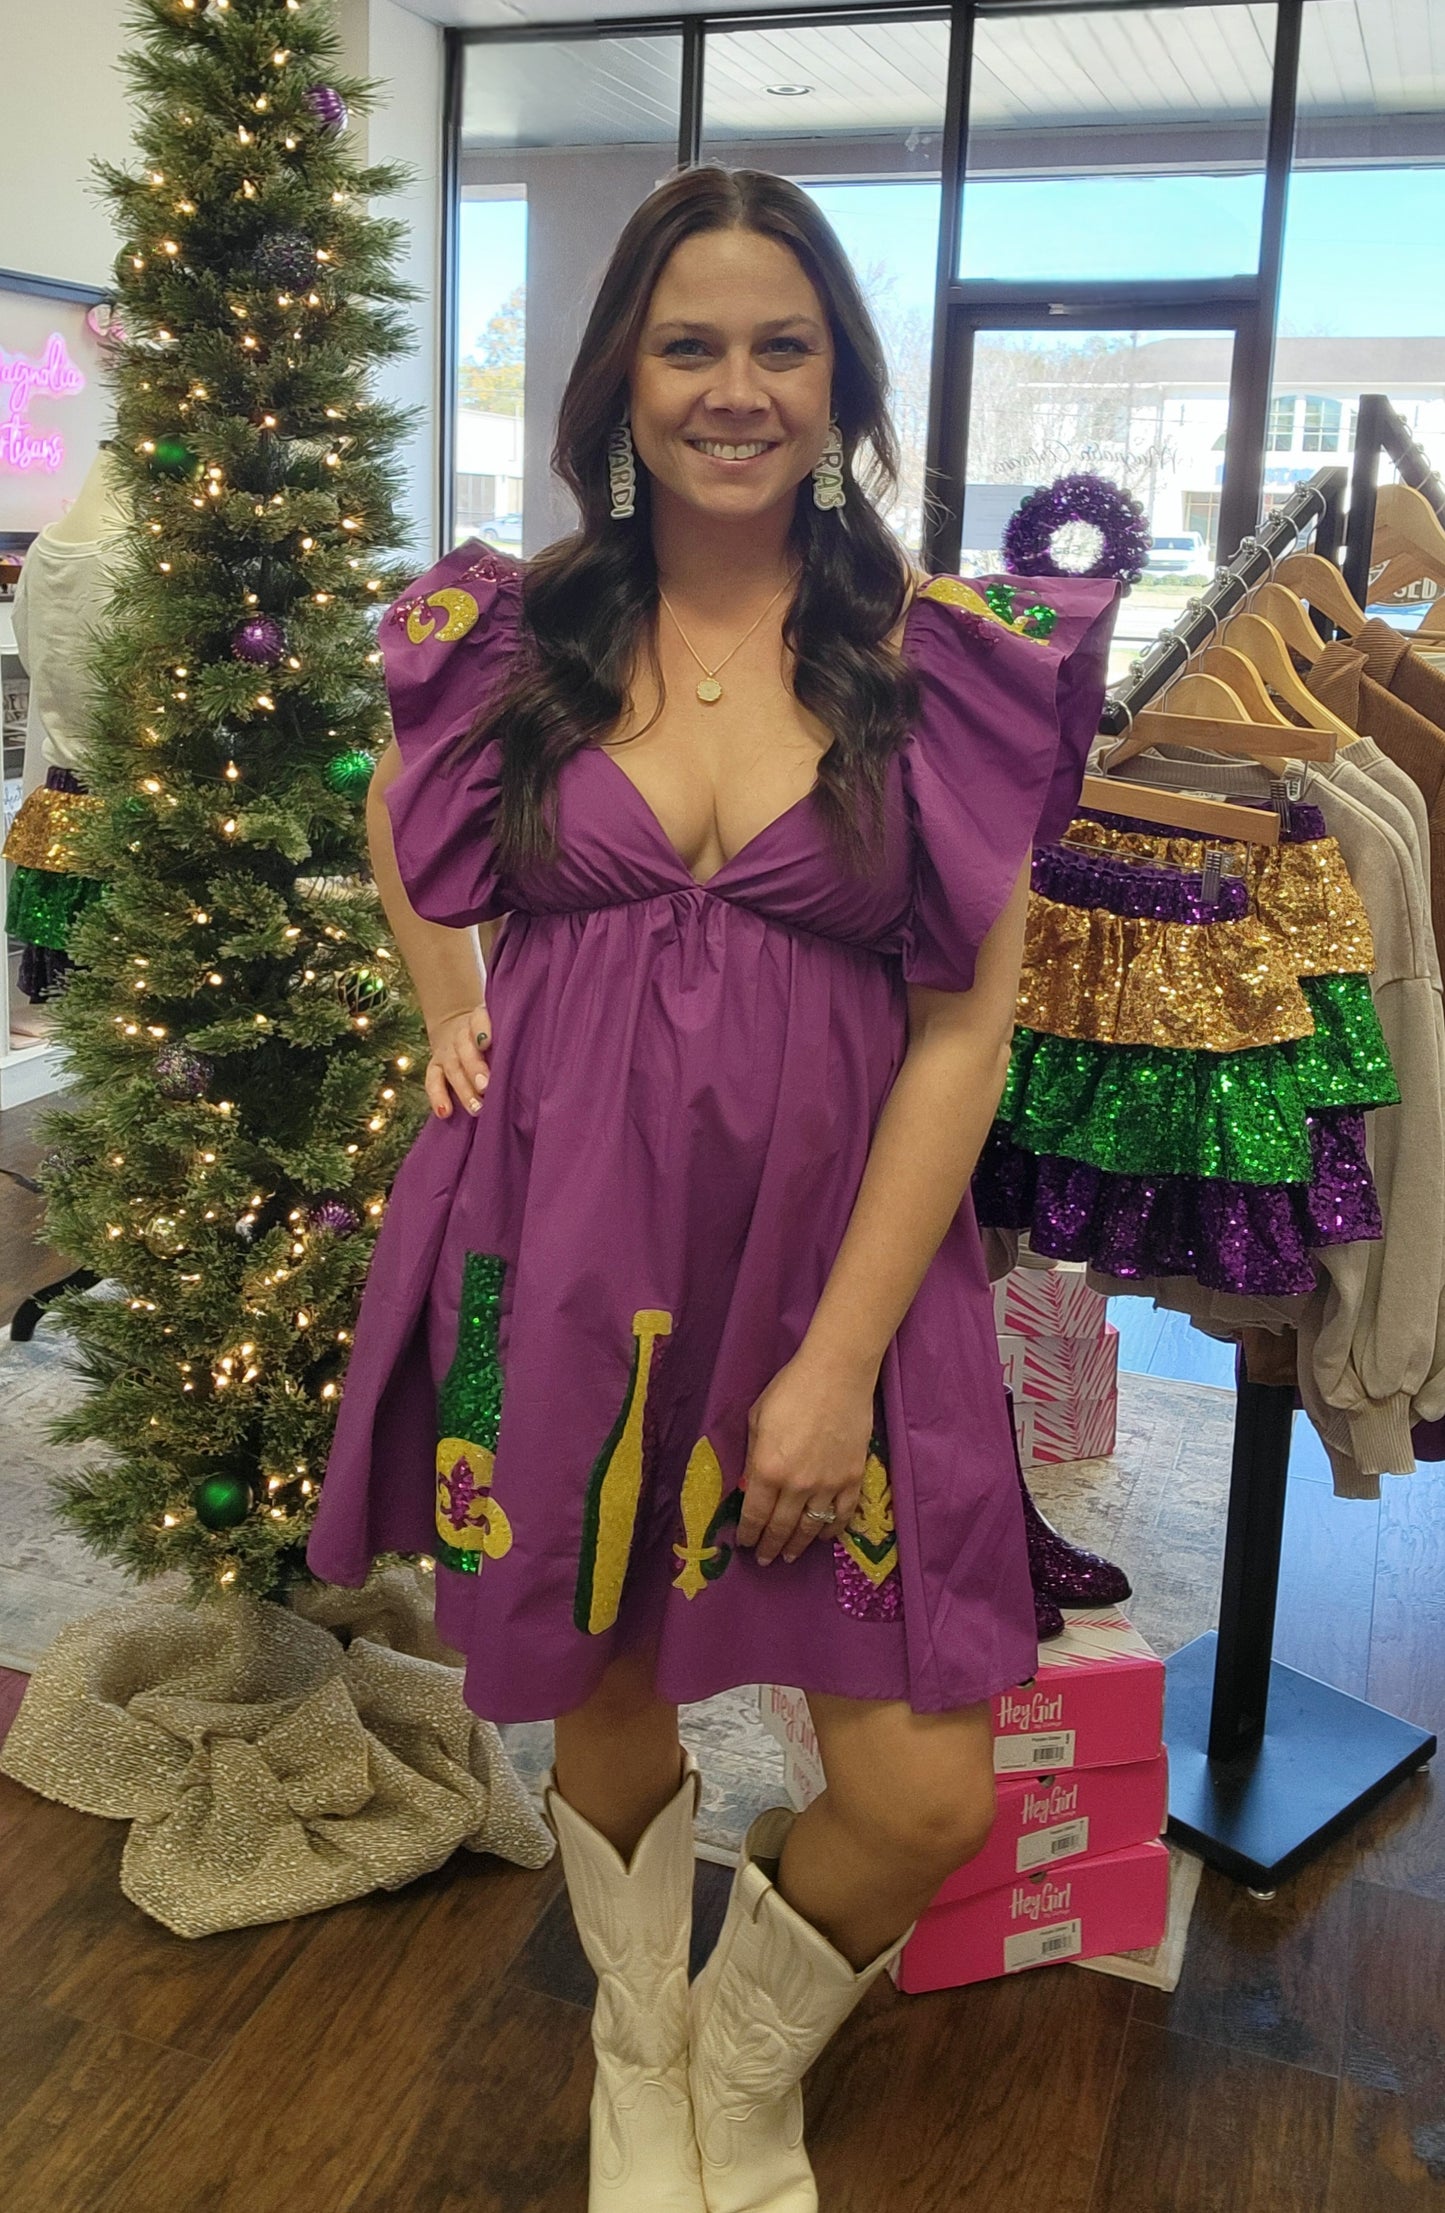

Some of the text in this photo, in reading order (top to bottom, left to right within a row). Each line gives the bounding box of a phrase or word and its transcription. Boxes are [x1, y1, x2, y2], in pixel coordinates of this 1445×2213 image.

[0, 338, 80, 412] agnolia
[0, 413, 63, 467] rtisans
[609, 427, 636, 517] MARDI
